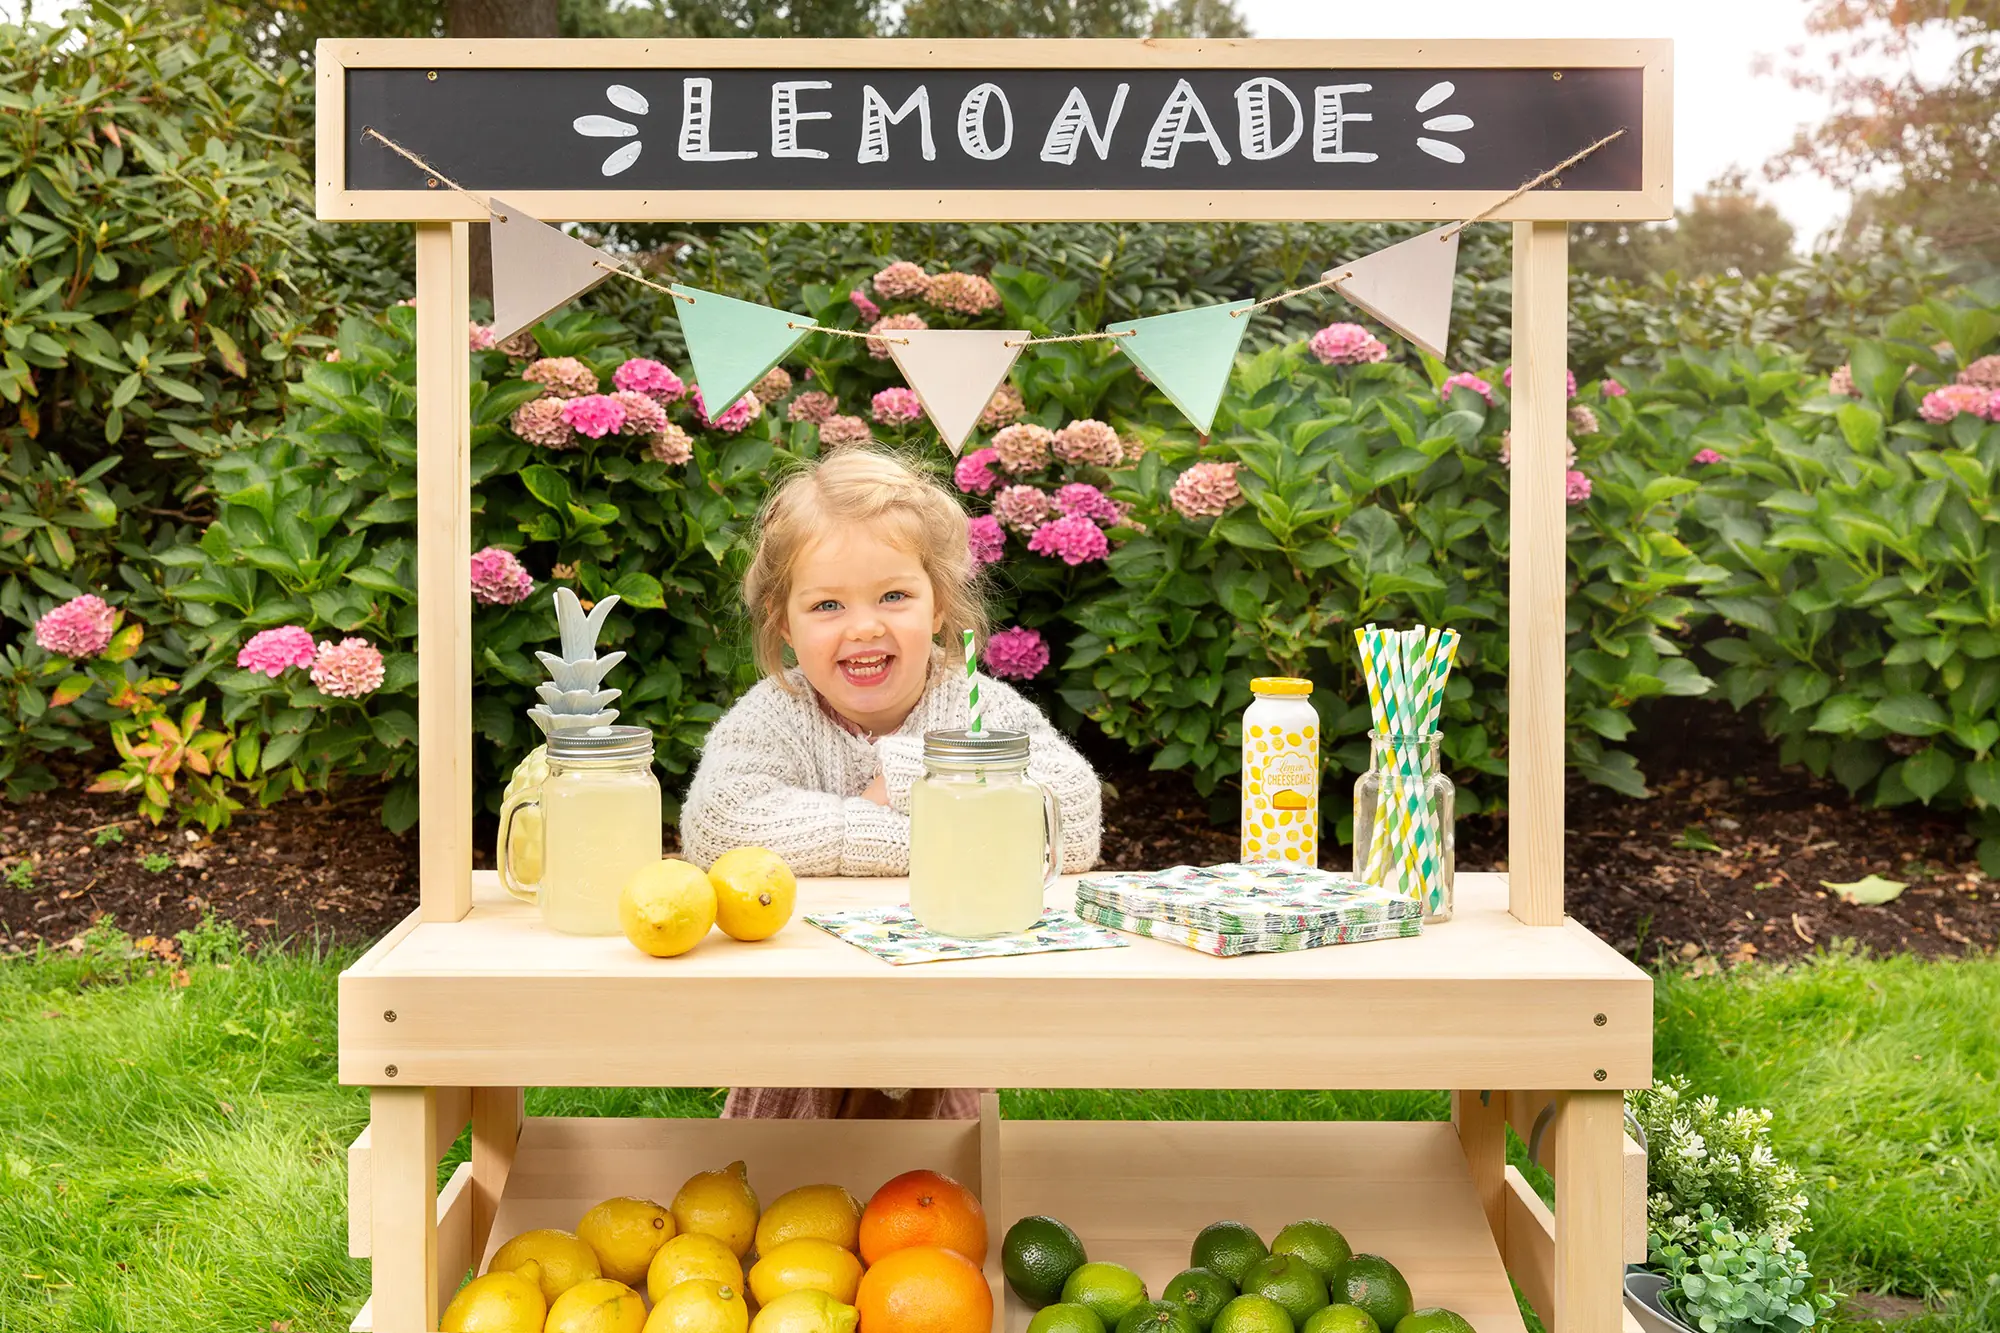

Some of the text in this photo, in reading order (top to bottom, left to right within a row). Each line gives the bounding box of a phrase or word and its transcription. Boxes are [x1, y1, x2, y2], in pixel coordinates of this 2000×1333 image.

[677, 76, 1380, 170] LEMONADE
[1276, 760, 1304, 774] Lemon
[1267, 773, 1311, 786] CHEESECAKE
